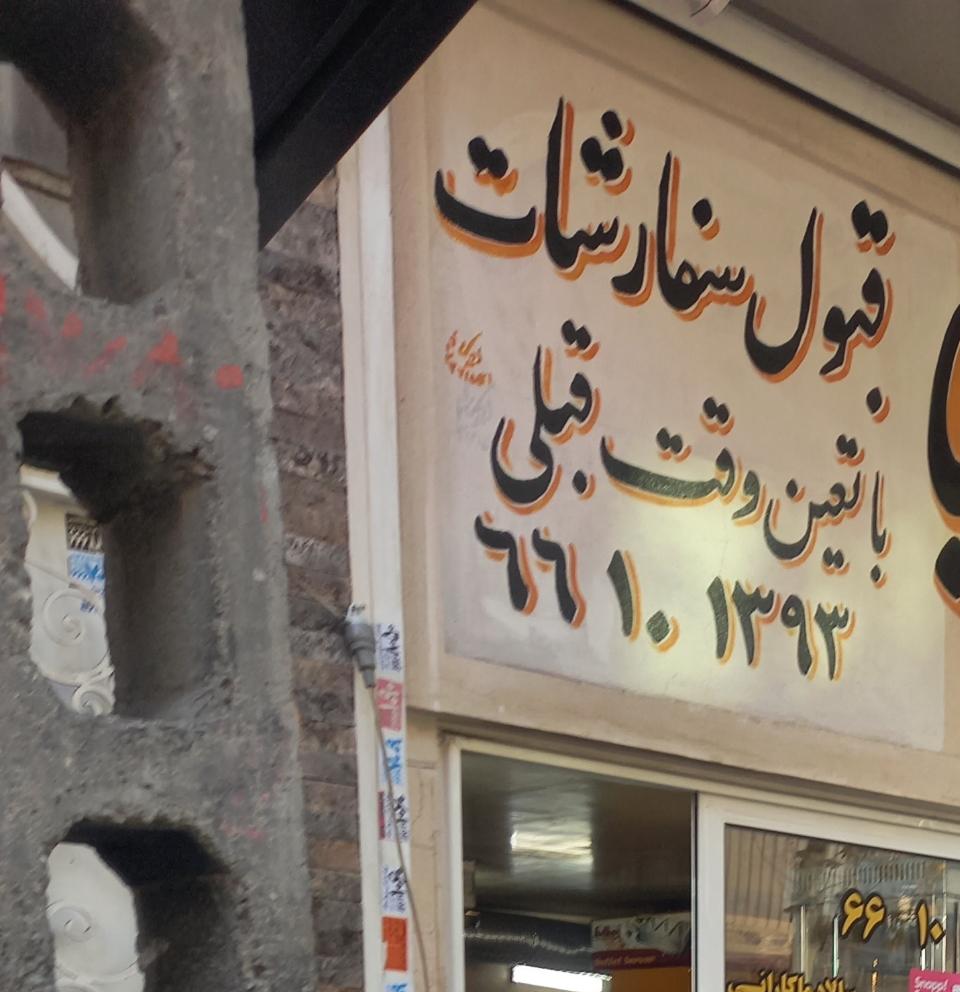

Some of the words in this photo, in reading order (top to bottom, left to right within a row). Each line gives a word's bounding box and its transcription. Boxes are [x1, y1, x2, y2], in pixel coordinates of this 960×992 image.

[434, 96, 754, 320] سفارشات
[745, 200, 895, 423] قبول
[490, 318, 600, 515] قبلی
[600, 396, 767, 521] وقت
[870, 470, 891, 588] با
[839, 888, 888, 942] ۶۶
